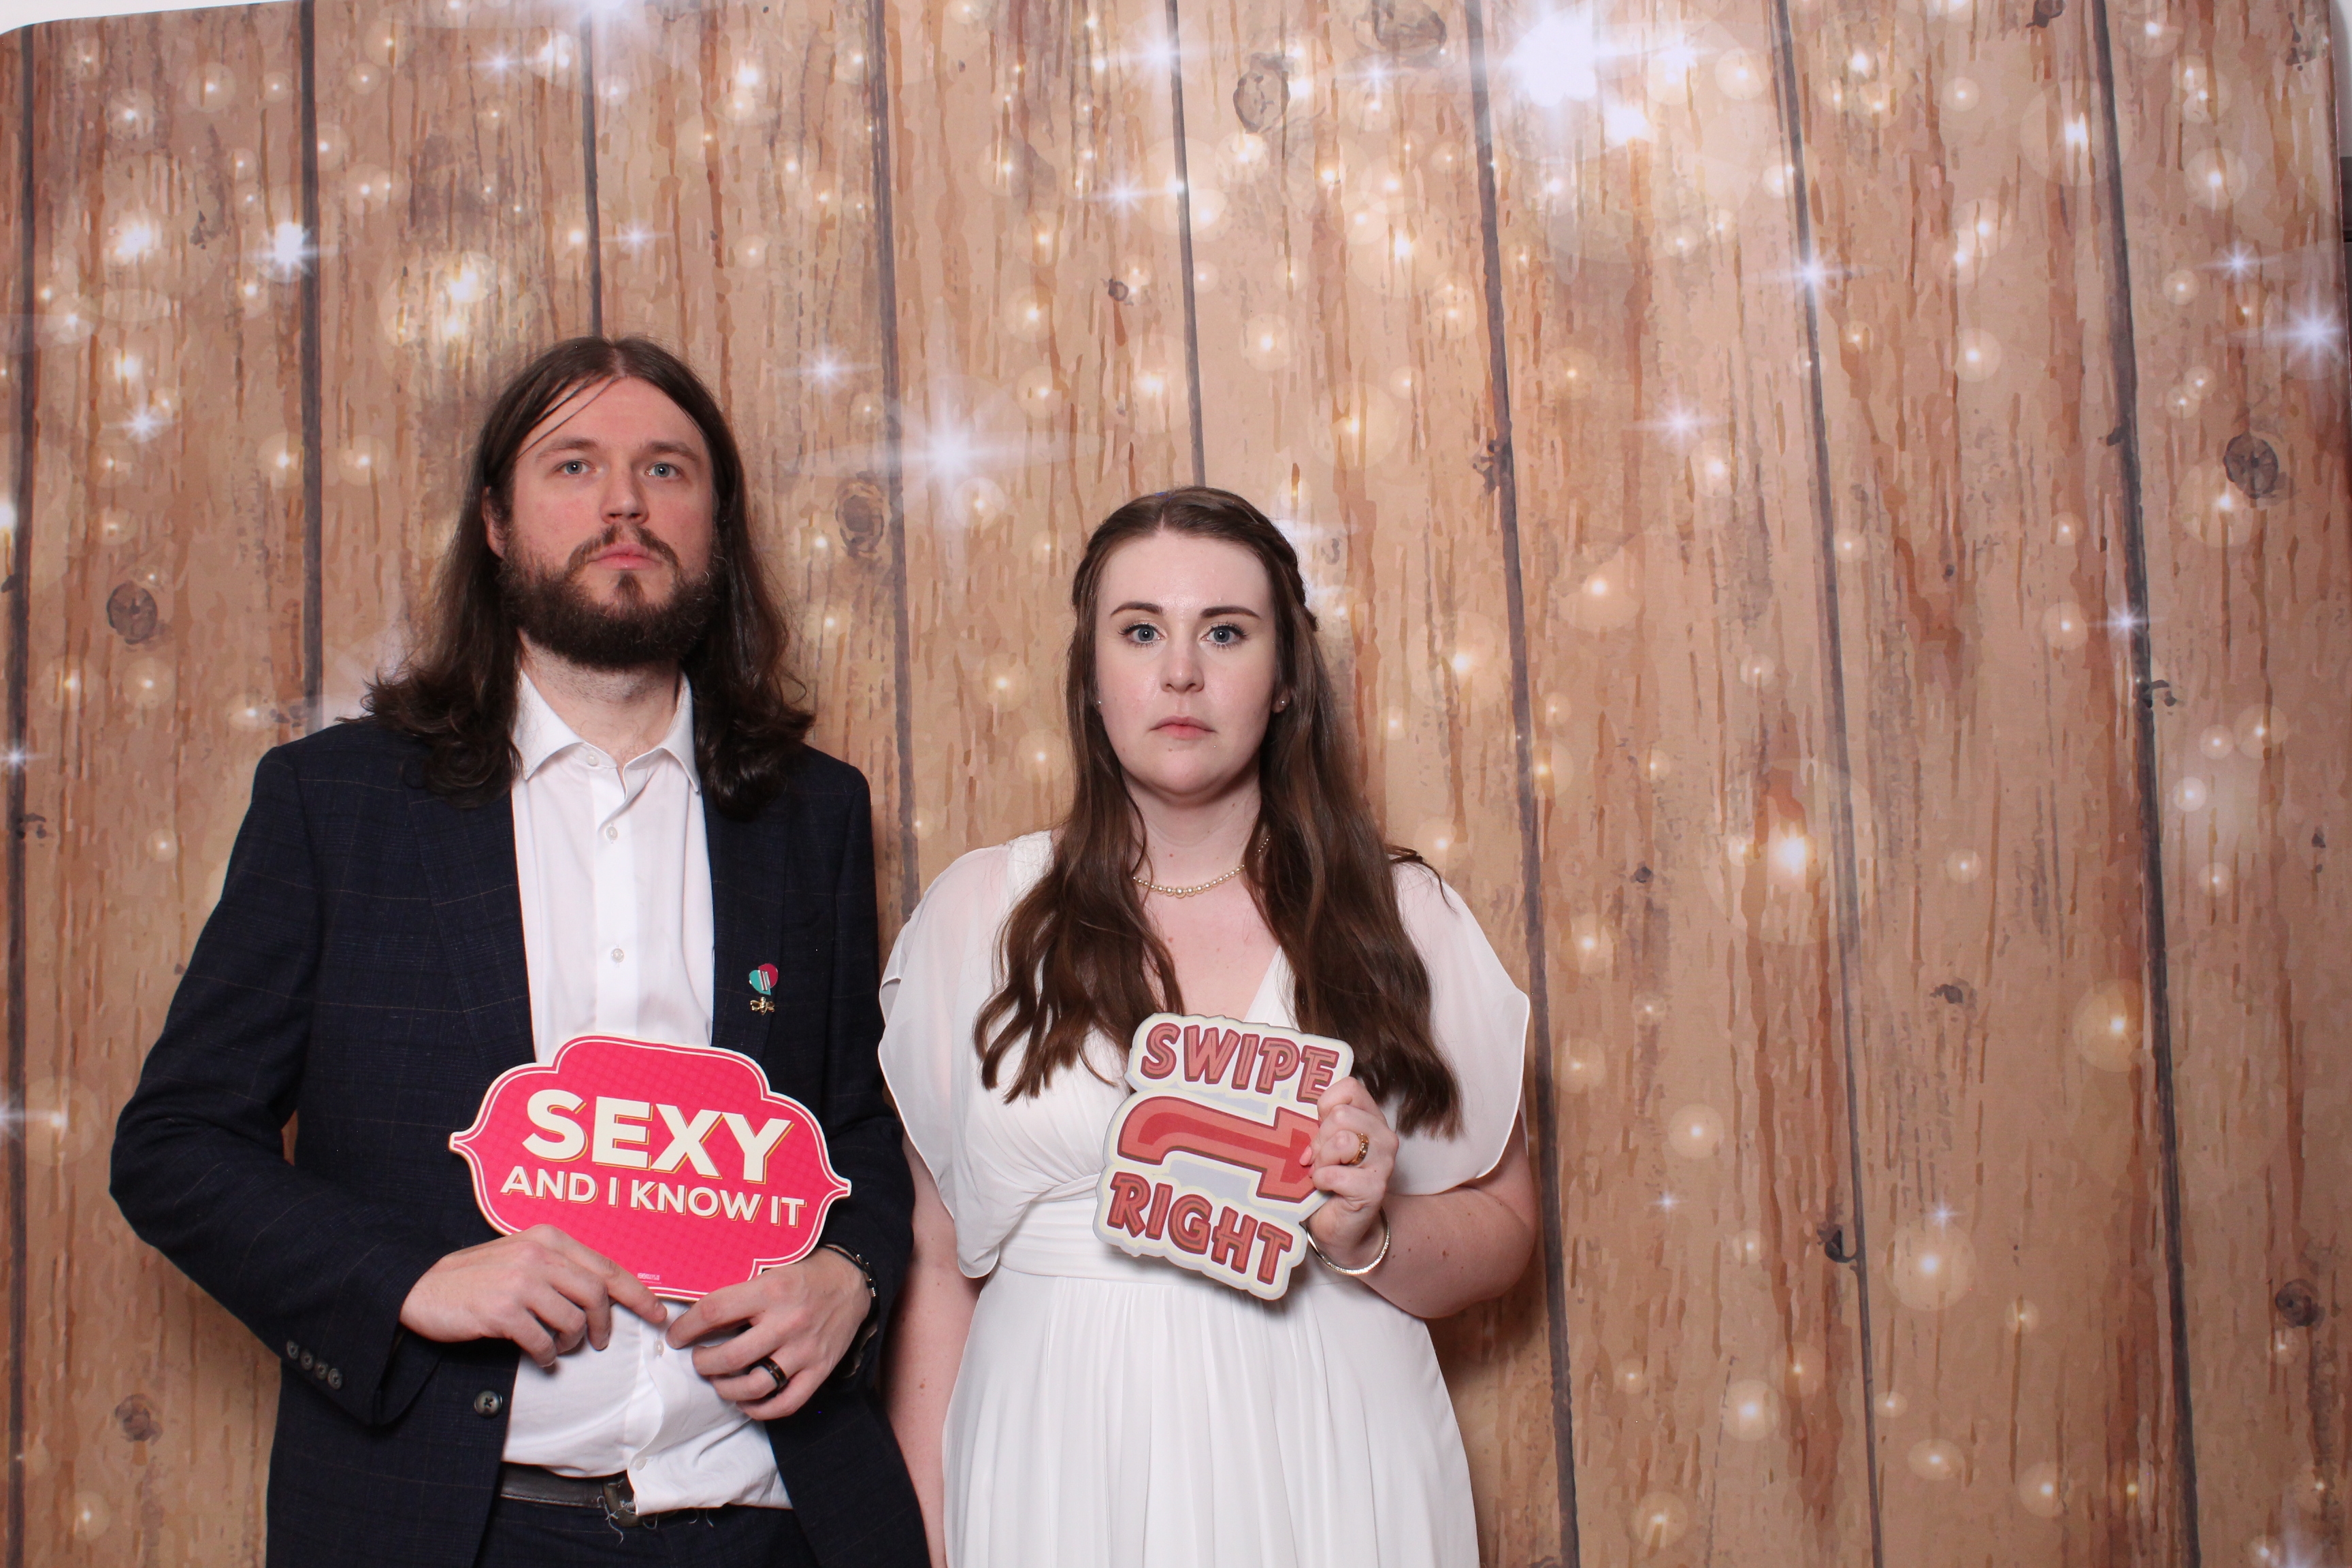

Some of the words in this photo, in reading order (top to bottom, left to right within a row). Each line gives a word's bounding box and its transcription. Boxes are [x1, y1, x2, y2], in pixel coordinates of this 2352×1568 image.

[1141, 1023, 1339, 1105] SWIPE
[521, 1089, 794, 1184] SEXY
[500, 1166, 598, 1204] AND
[608, 1177, 619, 1207] I
[630, 1179, 764, 1223] KNOW
[770, 1196, 807, 1228] IT
[1107, 1172, 1293, 1285] RIGHT
